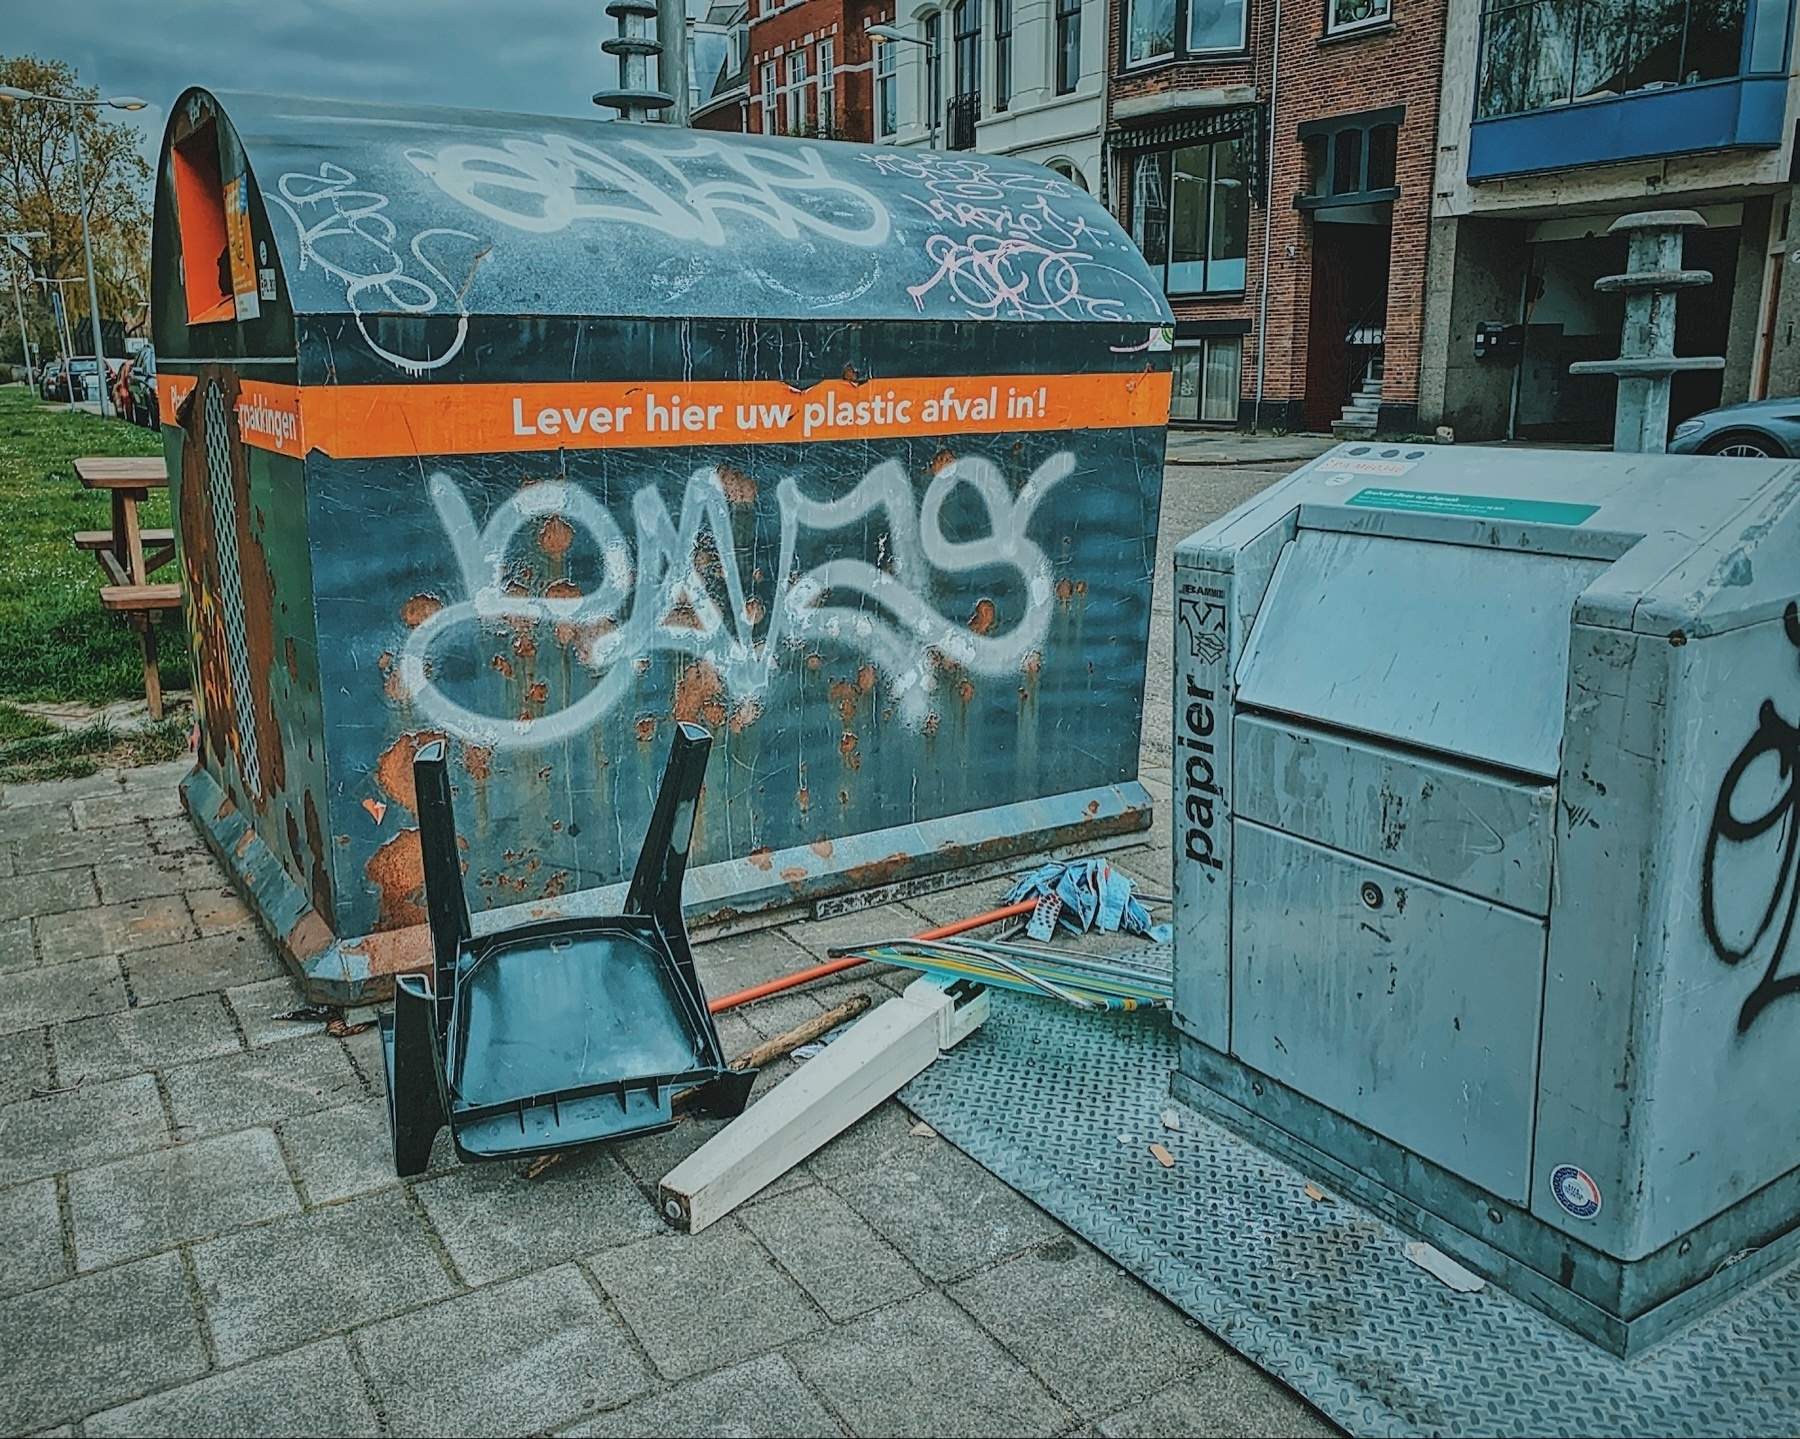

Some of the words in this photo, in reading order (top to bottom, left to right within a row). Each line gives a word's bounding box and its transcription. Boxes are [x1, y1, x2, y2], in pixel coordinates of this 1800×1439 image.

[239, 393, 297, 448] rpakkingen
[513, 398, 632, 436] Lever
[646, 393, 723, 432] hier
[736, 403, 792, 430] uw
[803, 390, 911, 438] plastic
[921, 386, 998, 423] afval
[1007, 387, 1047, 418] in!
[1177, 673, 1223, 871] papier
